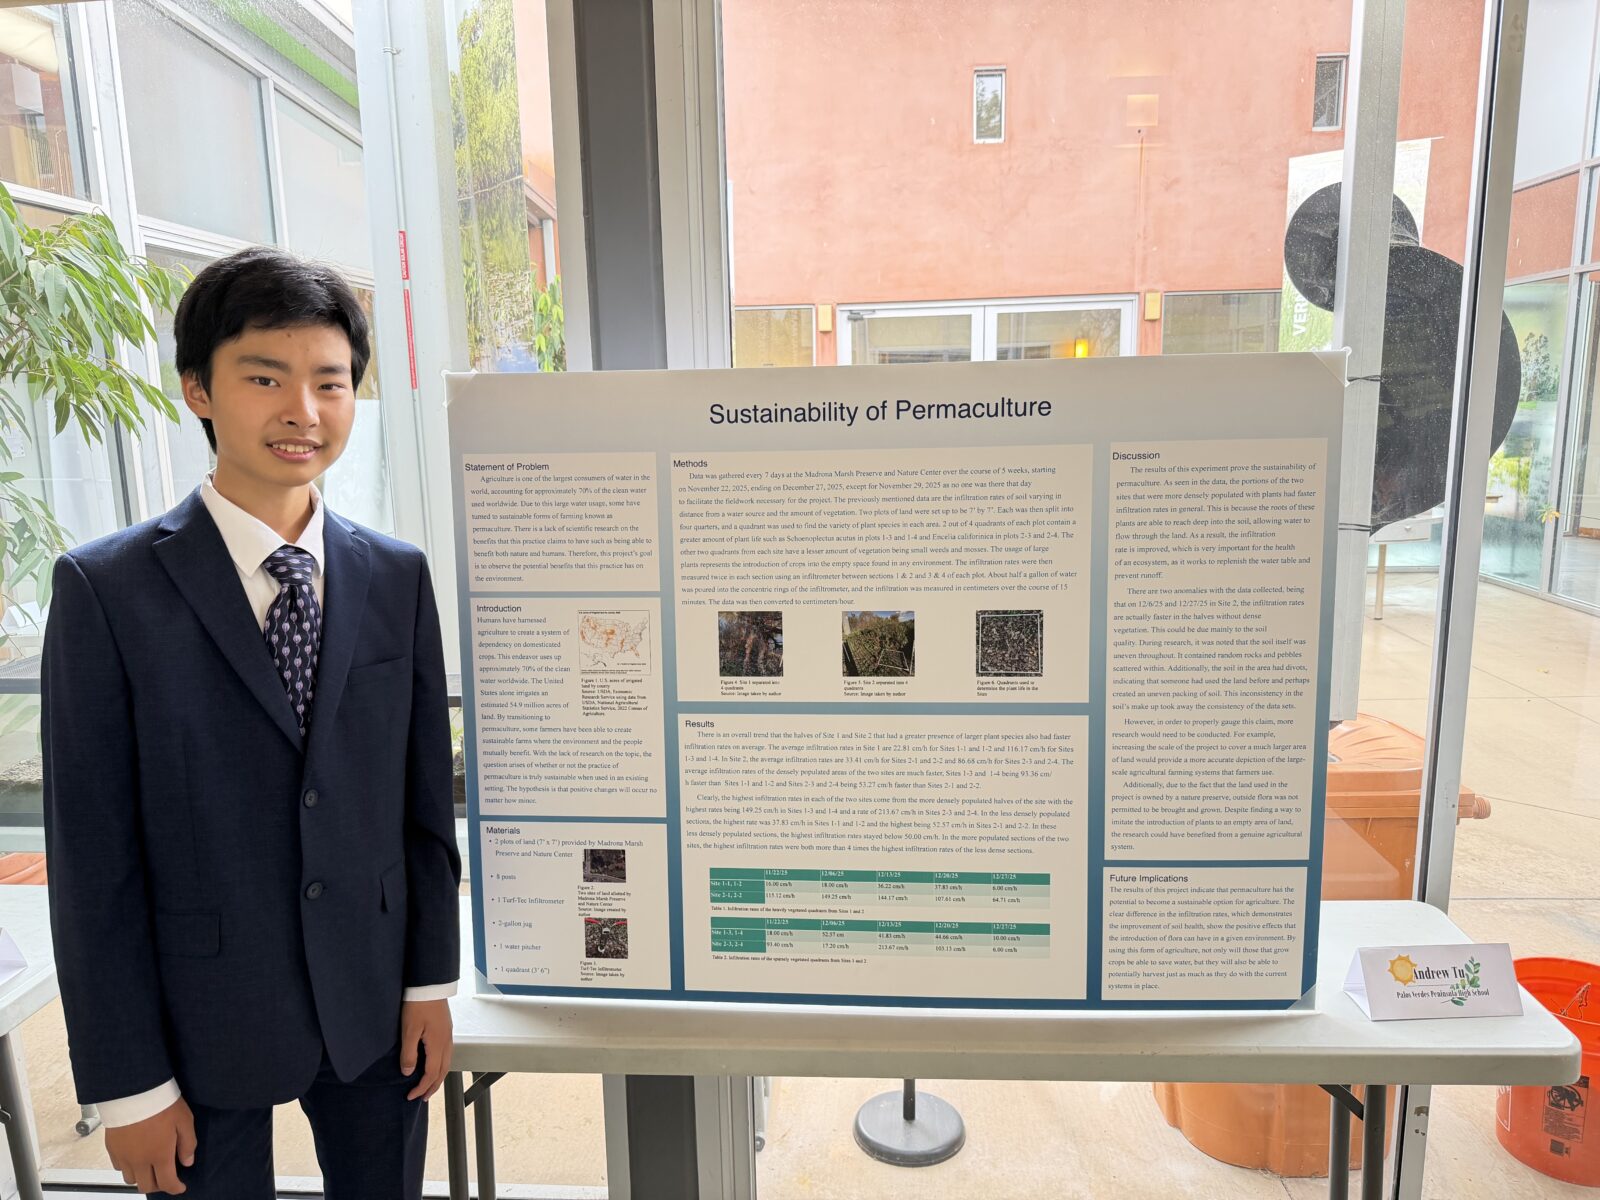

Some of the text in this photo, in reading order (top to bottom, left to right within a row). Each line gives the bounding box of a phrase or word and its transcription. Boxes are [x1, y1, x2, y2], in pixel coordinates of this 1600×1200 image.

[710, 396, 1052, 429] Sustainability of Permaculture
[1112, 452, 1160, 460] Discussion
[480, 475, 514, 483] Agriculture
[1129, 769, 1166, 777] agricultural
[1168, 769, 1193, 777] farming
[713, 843, 735, 851] highest
[881, 845, 904, 853] highest
[1139, 874, 1189, 884] Implications
[1230, 886, 1271, 894] permaculture
[1413, 966, 1465, 980] Andrew Tu
